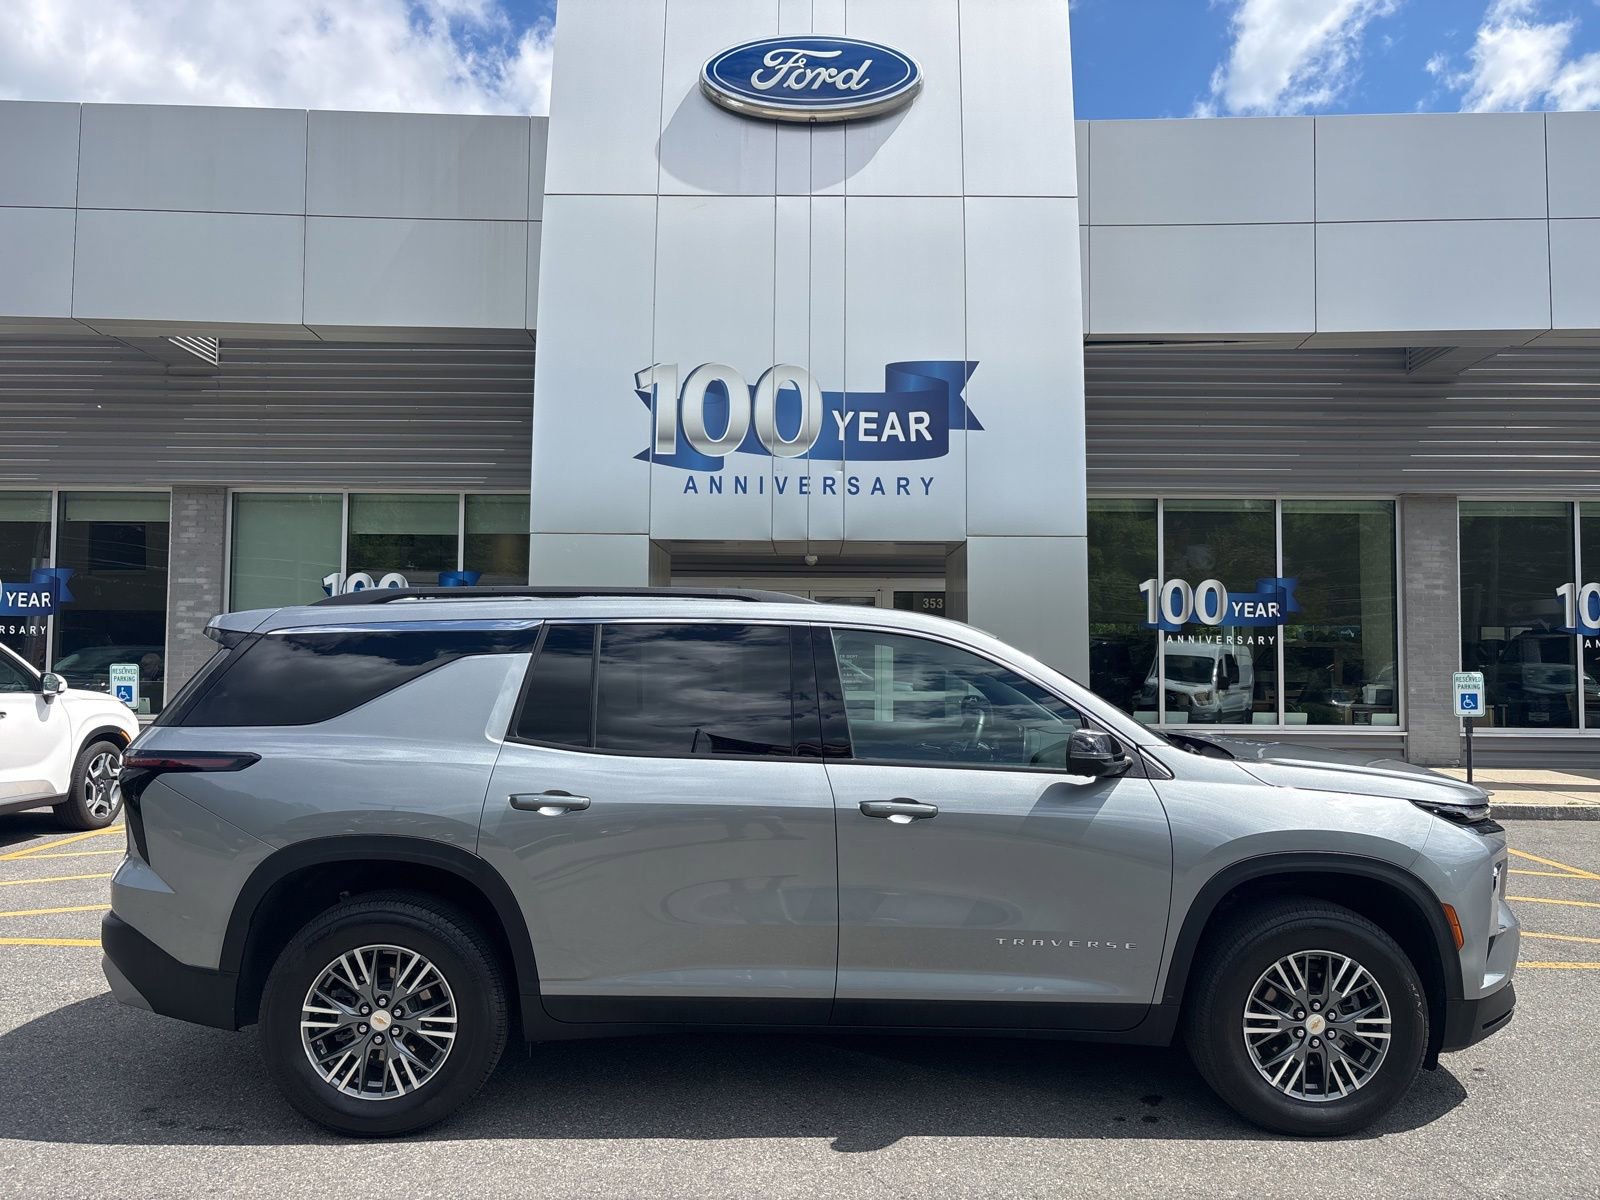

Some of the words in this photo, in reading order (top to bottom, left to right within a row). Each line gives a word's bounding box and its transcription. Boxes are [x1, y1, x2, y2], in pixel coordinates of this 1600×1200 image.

[750, 48, 873, 91] Ford
[634, 362, 824, 458] 100
[831, 409, 934, 442] YEAR
[683, 474, 936, 497] ANNIVERSARY
[5, 591, 52, 608] YEAR
[922, 598, 944, 609] 353
[1138, 578, 1229, 626] 100
[1231, 600, 1281, 619] YEAR
[1165, 634, 1276, 645] ANNIVERSARY
[995, 937, 1137, 950] TRAVERSE
